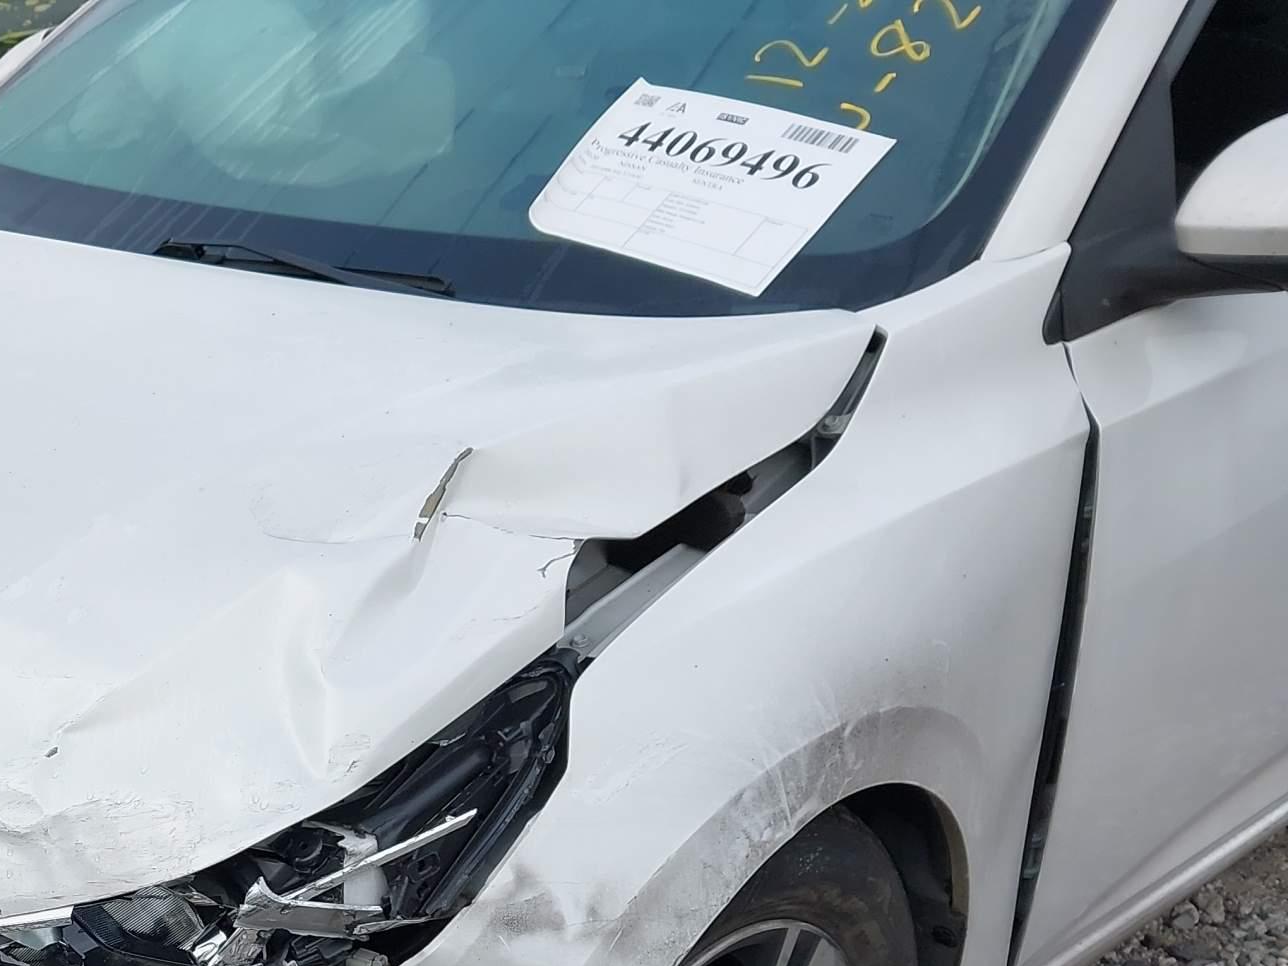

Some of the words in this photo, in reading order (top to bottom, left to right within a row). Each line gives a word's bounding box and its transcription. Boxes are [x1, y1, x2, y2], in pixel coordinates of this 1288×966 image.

[591, 138, 648, 162] Progressive
[648, 153, 690, 174] Casualty
[693, 162, 745, 186] Insurance
[618, 121, 832, 189] 44069496
